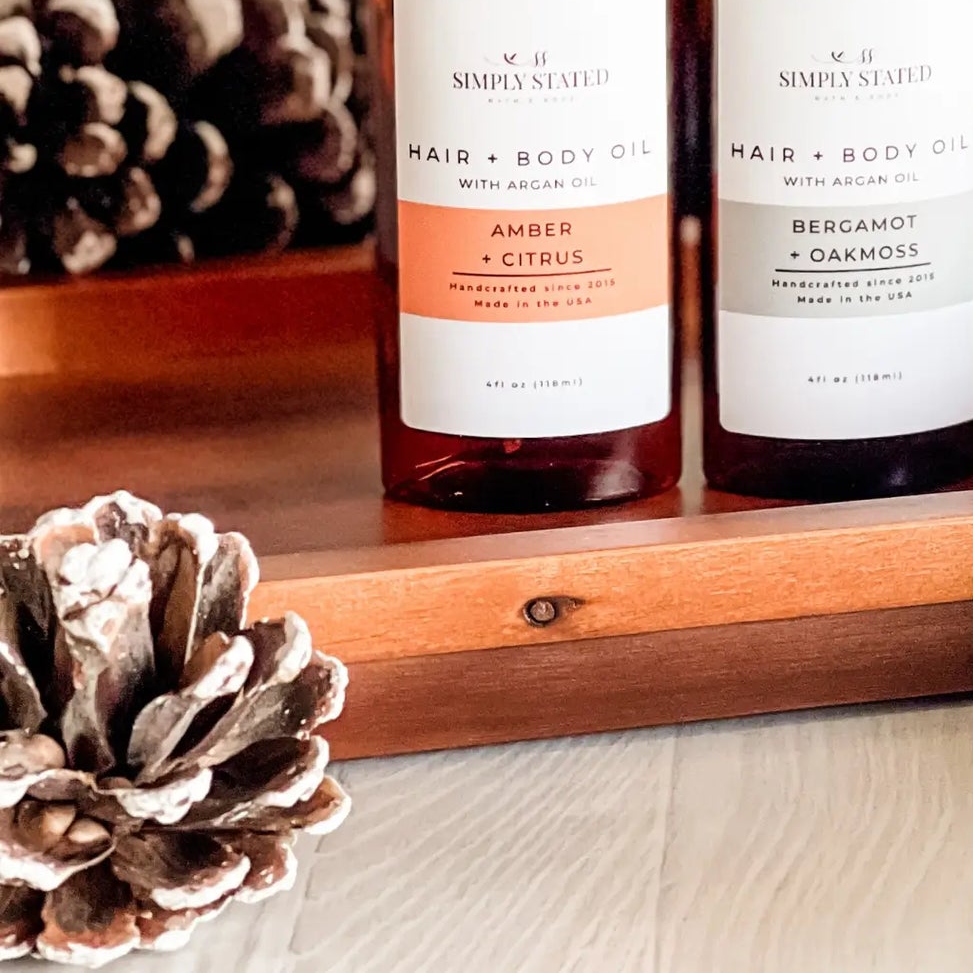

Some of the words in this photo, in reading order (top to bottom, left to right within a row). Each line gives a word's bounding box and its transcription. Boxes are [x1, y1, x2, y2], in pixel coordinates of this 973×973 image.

[453, 72, 526, 90] SIMPLY
[532, 69, 608, 89] STATED
[780, 71, 853, 88] SIMPLY
[859, 65, 931, 86] STATED
[409, 144, 469, 164] HAIR
[487, 153, 498, 164] +
[518, 148, 593, 166] BODY
[611, 140, 651, 159] OIL
[732, 143, 794, 162] HAIR
[813, 150, 824, 161] +
[843, 144, 916, 163] BODY
[932, 135, 968, 154] OIL
[458, 178, 500, 191] WITH
[506, 178, 565, 191] ARGAN
[570, 176, 598, 189] OIL
[783, 175, 826, 187] WITH
[831, 174, 888, 187] ARGAN
[894, 170, 920, 184] OIL
[491, 222, 571, 237] AMBER
[793, 215, 917, 234] BERGAMOT
[481, 253, 492, 264] +
[502, 250, 583, 267] CITRUS
[789, 250, 801, 260] +
[810, 243, 920, 263] OAKMOSS
[449, 282, 536, 293] Handcrafted
[543, 283, 581, 293] since
[771, 278, 859, 289] Handcrafted
[866, 277, 903, 288] since
[474, 299, 509, 309] Made
[516, 299, 529, 309] in
[536, 299, 560, 308] the
[565, 296, 593, 307] USA
[796, 295, 832, 304] Made
[839, 295, 852, 304] in
[859, 294, 882, 304] the
[887, 290, 913, 301] USA
[485, 380, 505, 389] 4fl
[511, 381, 526, 389] oz
[807, 375, 827, 384] 4fl
[833, 376, 848, 384] oz
